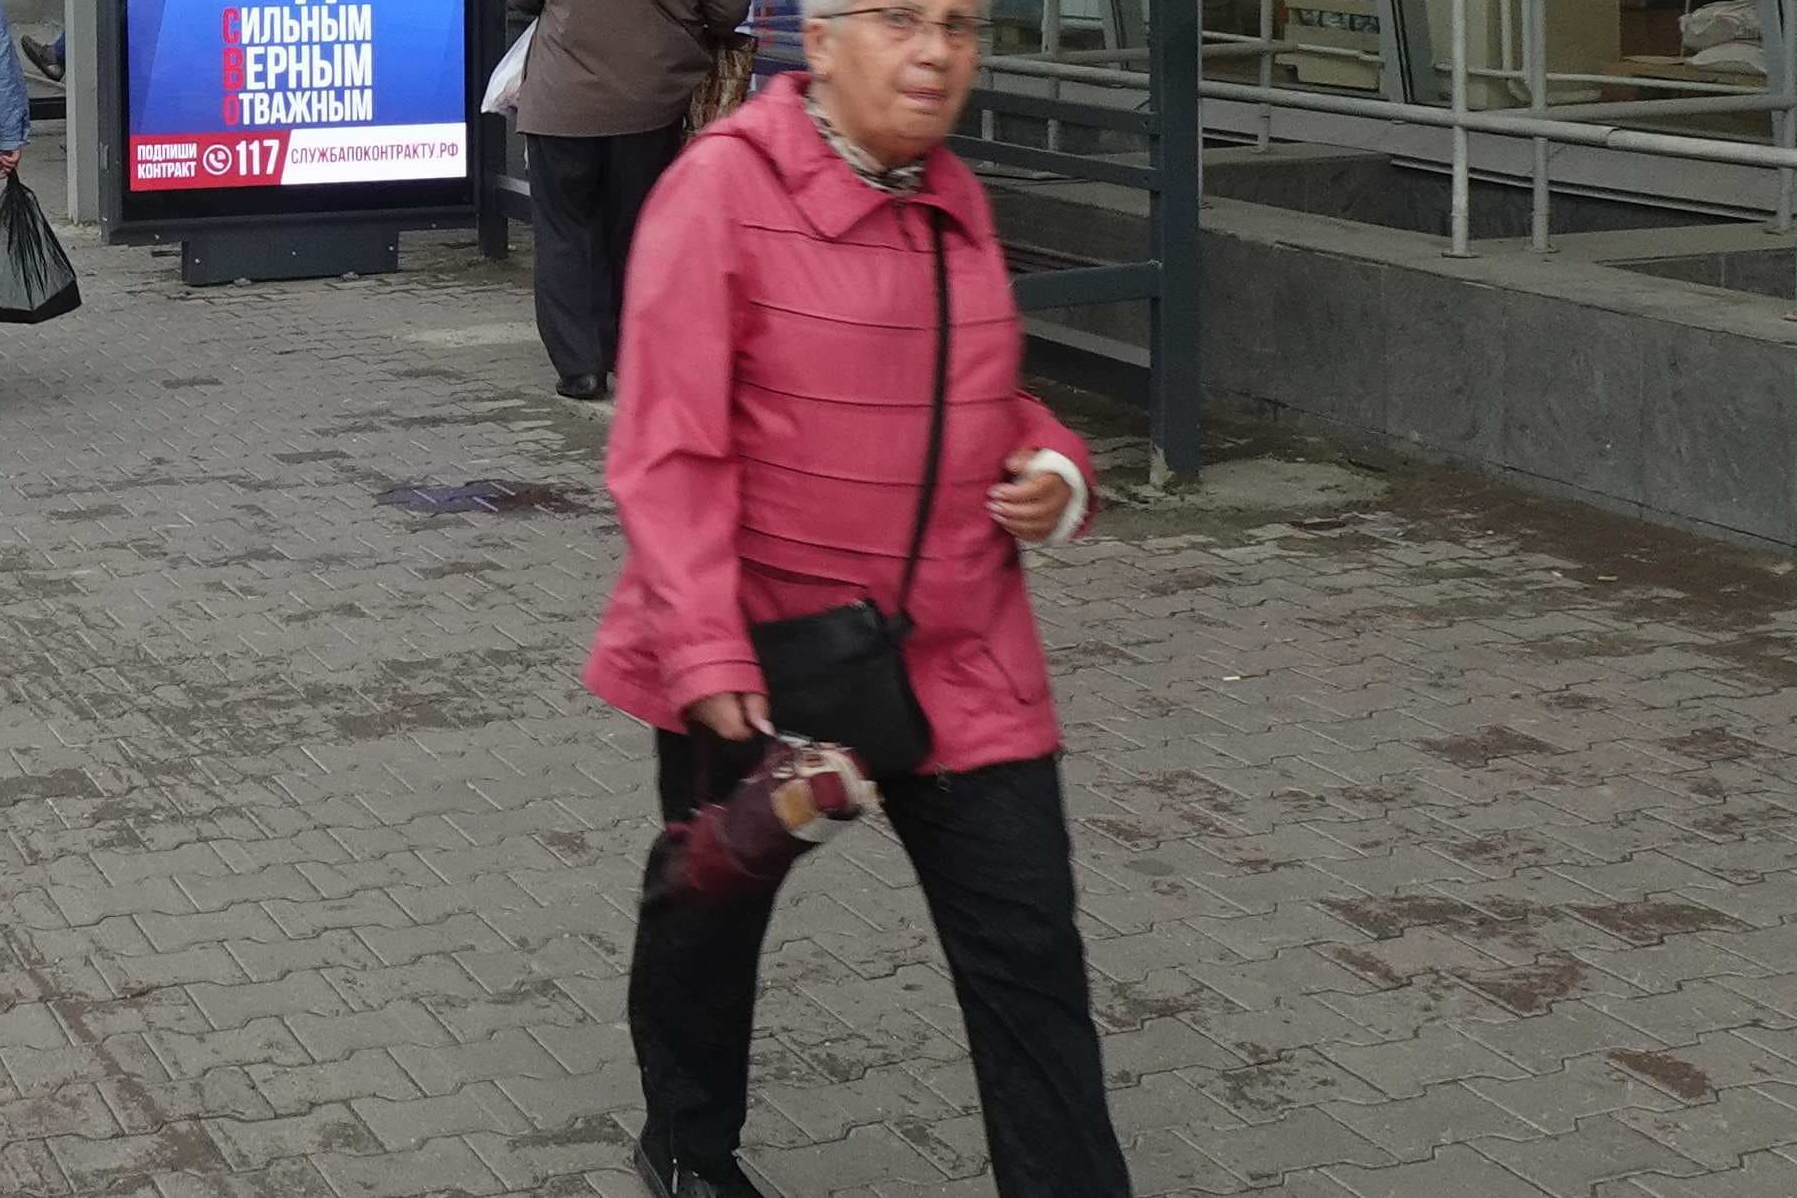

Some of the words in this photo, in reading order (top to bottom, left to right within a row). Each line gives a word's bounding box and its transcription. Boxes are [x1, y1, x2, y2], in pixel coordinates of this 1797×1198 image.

[222, 4, 372, 44] СИЛЬНЫМ
[222, 43, 373, 91] ВЕРНЫМ
[222, 89, 374, 127] ОТВАЖНЫМ
[137, 143, 198, 162] ПОДПИШИ
[137, 160, 197, 179] КОНТРАКТ
[235, 138, 281, 177] 117
[290, 142, 459, 165] СЛУЖБАПОКОНТРАКТУ.РФ
